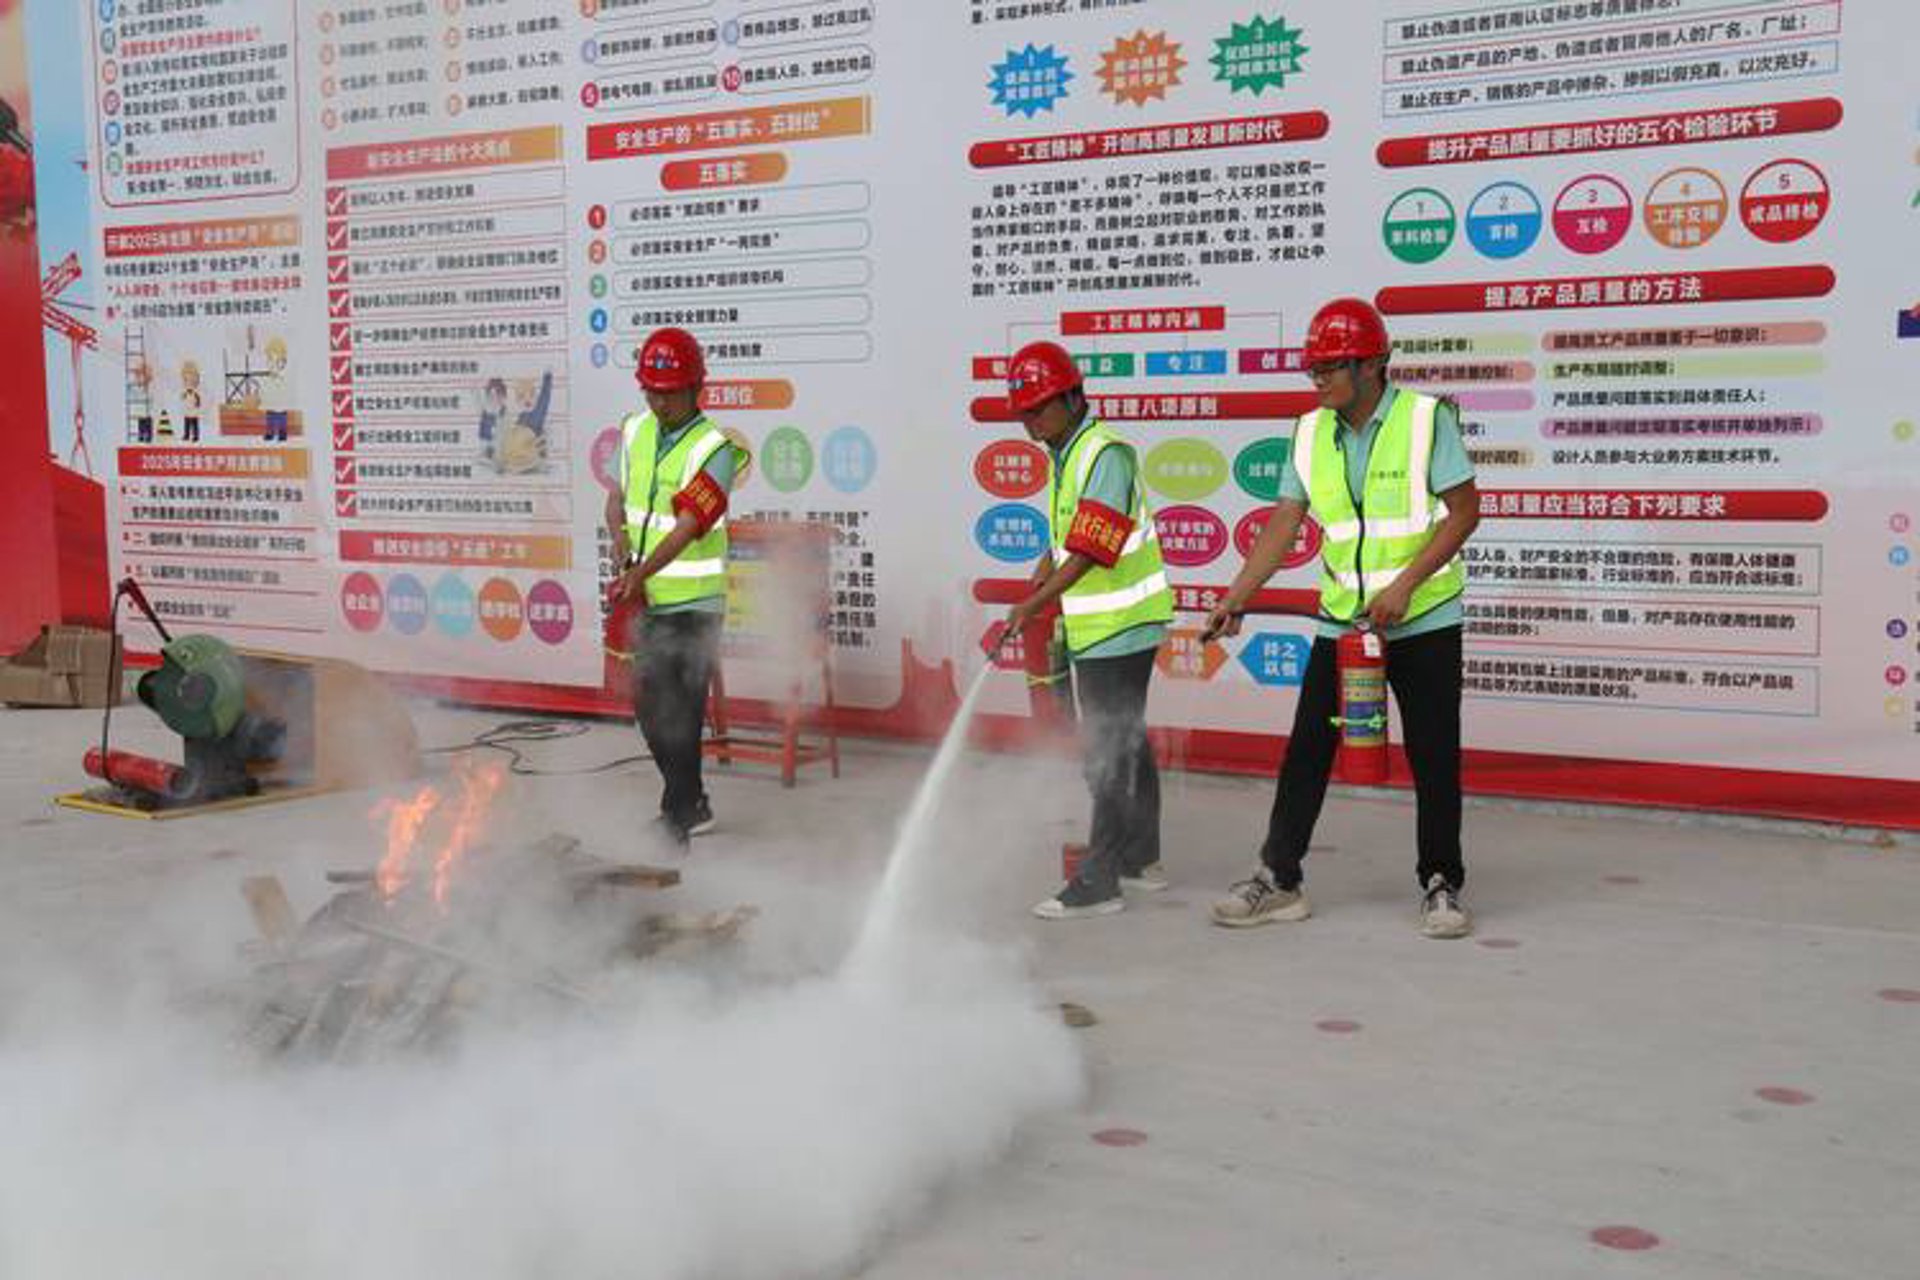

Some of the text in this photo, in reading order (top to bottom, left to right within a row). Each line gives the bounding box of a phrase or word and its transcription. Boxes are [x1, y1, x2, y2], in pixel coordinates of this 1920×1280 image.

[1427, 109, 1779, 162] 提升产品质量要抓好的五个检验环节
[1484, 276, 1702, 309] 提高产品质量的方法
